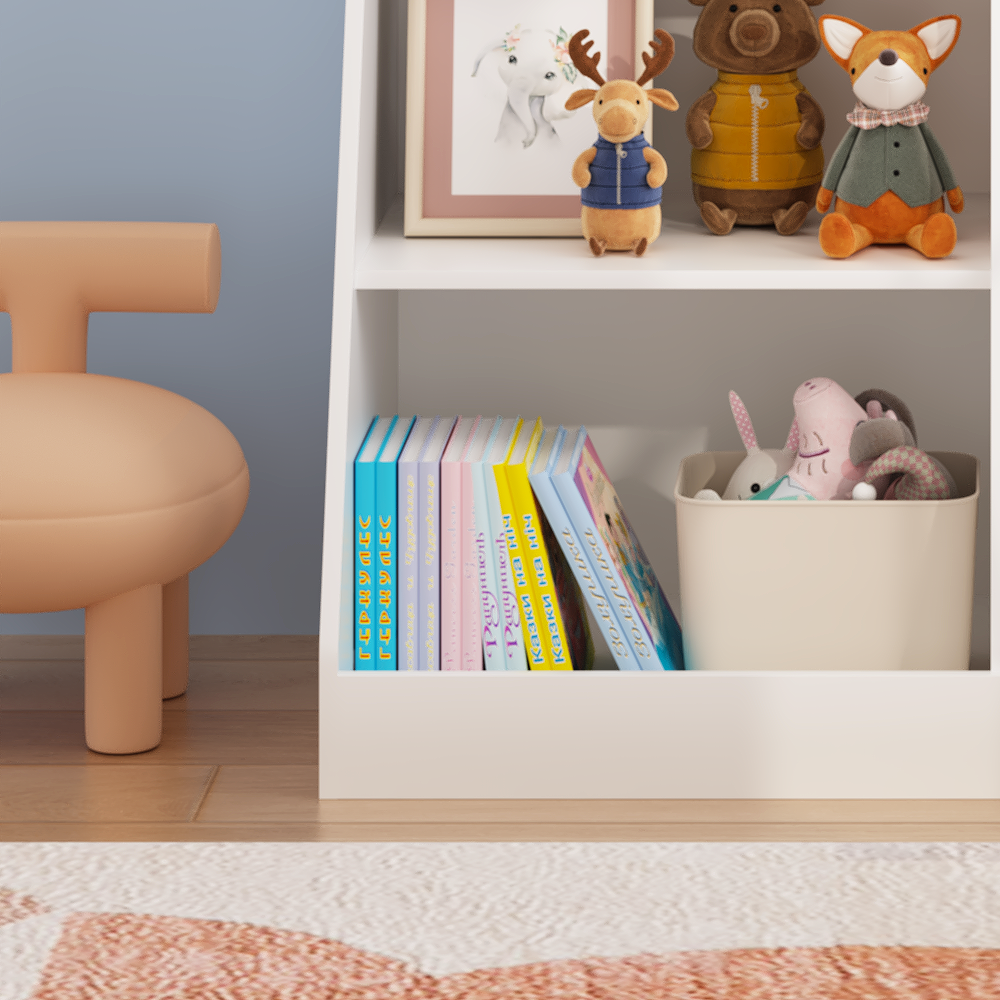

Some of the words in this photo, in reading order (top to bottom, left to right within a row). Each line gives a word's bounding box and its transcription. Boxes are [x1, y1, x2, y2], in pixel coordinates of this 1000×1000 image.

[502, 514, 518, 550] ніч
[523, 513, 539, 550] ніч
[358, 515, 371, 660] ГЕРКУЛЕС
[379, 515, 391, 660] ГЕРКУЛЕС
[512, 556, 526, 588] на
[533, 556, 548, 588] на
[520, 593, 544, 665] Казки
[541, 593, 565, 665] Казки
